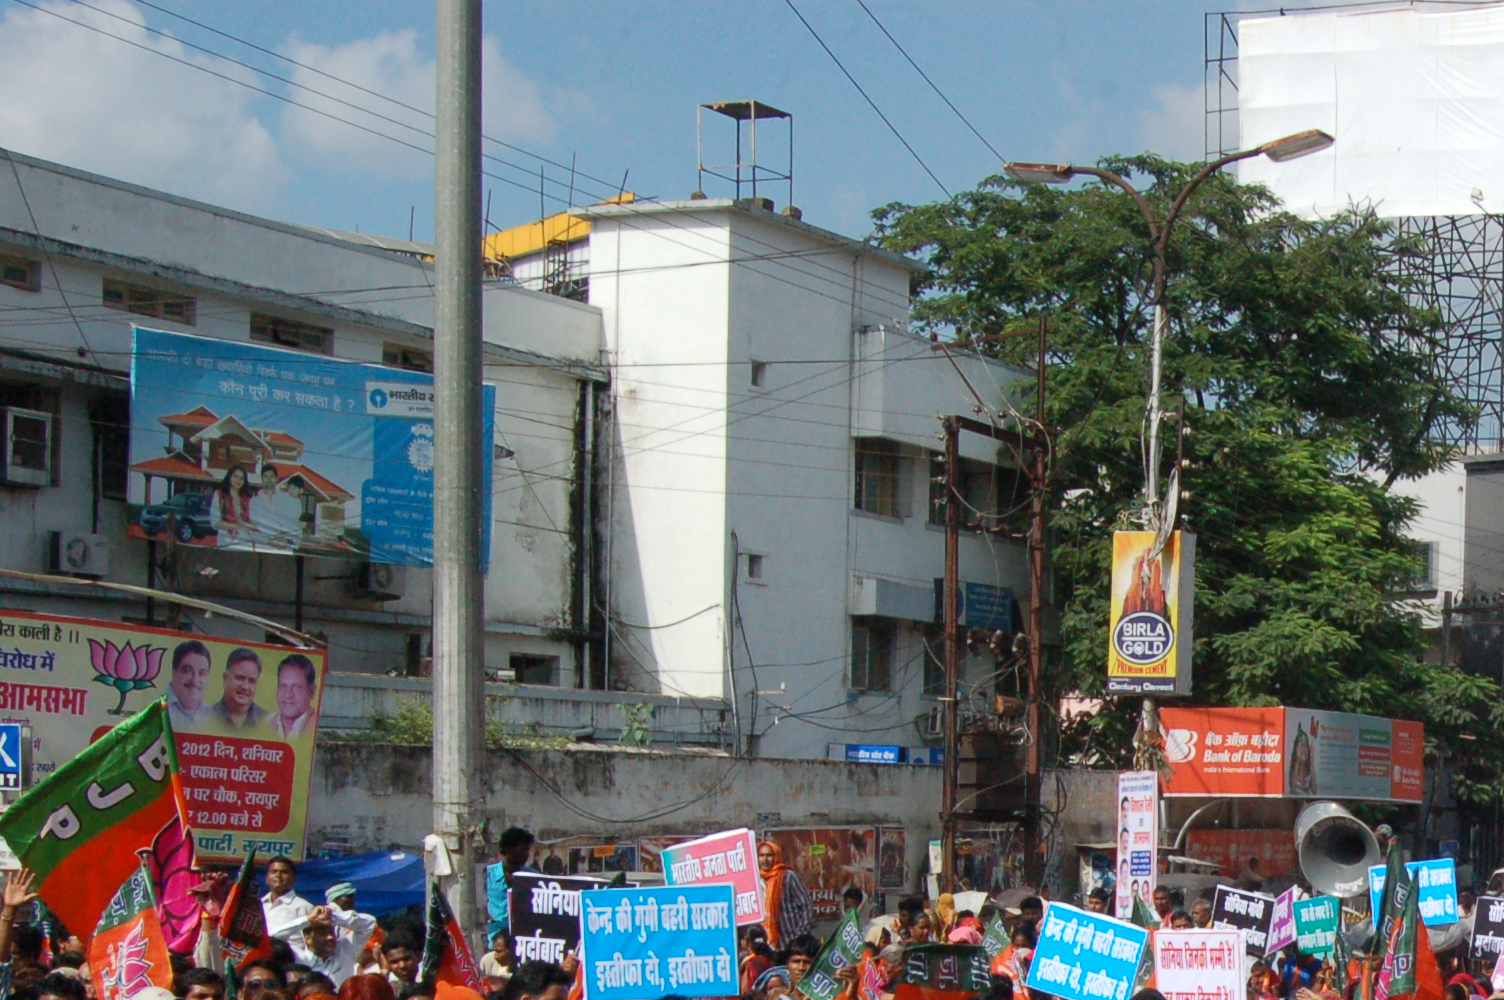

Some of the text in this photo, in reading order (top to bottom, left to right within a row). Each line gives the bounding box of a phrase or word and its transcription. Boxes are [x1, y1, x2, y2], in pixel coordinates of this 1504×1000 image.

[219, 378, 244, 396] कौन
[249, 383, 268, 402] पूरी
[273, 388, 291, 402] कर
[295, 391, 328, 409] सकता
[333, 395, 341, 412] है
[389, 388, 426, 401] भारतीय
[19, 623, 50, 641] काली
[54, 625, 62, 642] है
[1123, 622, 1165, 637] BIRLA
[1122, 641, 1164, 656] GOLD
[41, 651, 54, 672] में
[0, 681, 87, 716] आमसभा
[1205, 731, 1222, 746] बैंक
[1251, 731, 1280, 748] बड़ौदा
[183, 740, 284, 763] 2012 दिन, शनिवार
[1203, 750, 1281, 762] Bank of Baroda
[190, 765, 267, 783] एकात्म परिसर
[194, 785, 279, 809] घर चौक, रायपुर
[197, 810, 262, 828] 12.00 बजे से
[198, 833, 237, 855] पार्टी,
[670, 839, 747, 885] भारतीय जनता पार्टी
[1224, 894, 1265, 919] सोनिया गांधी
[585, 895, 730, 944] केन्द्र की गुंगी बहरी सरकार
[1045, 910, 1066, 942] केन्द्र
[1063, 917, 1079, 945] की
[1092, 928, 1115, 956] बहरी
[1111, 936, 1141, 964] सरकार
[1161, 941, 1184, 970] सोनिया
[1185, 941, 1207, 970] जिनकी
[1209, 941, 1225, 970] मम्मी
[595, 946, 731, 991] इस्तीफा दो, इस्तीफा दो
[1036, 955, 1072, 986] इस्तीफा
[1069, 961, 1082, 995] दो,
[1082, 969, 1119, 1000] इस्तीफा
